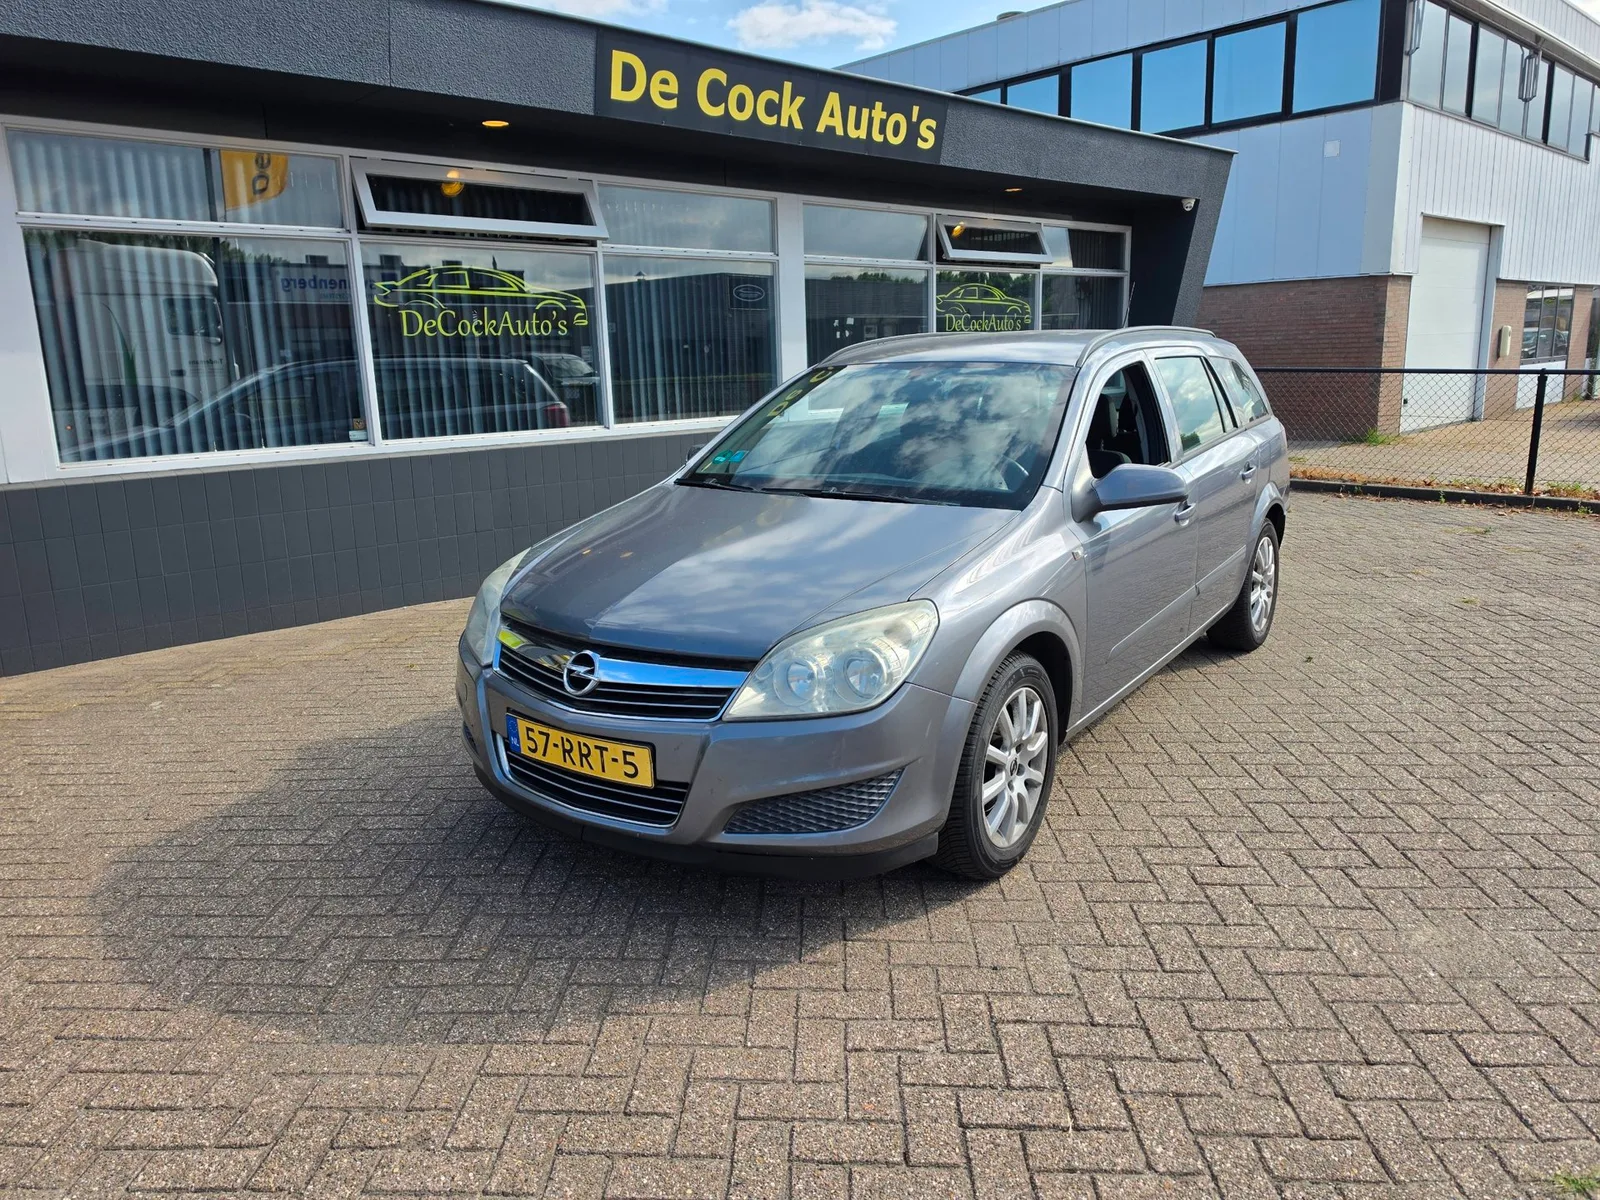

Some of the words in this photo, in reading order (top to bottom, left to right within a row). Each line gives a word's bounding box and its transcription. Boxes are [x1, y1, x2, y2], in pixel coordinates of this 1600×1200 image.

[610, 49, 679, 110] De
[696, 67, 806, 130] Cock
[816, 91, 937, 150] Auto's
[398, 306, 568, 337] DeCockAuto's
[525, 726, 639, 779] 57-RRT-5
